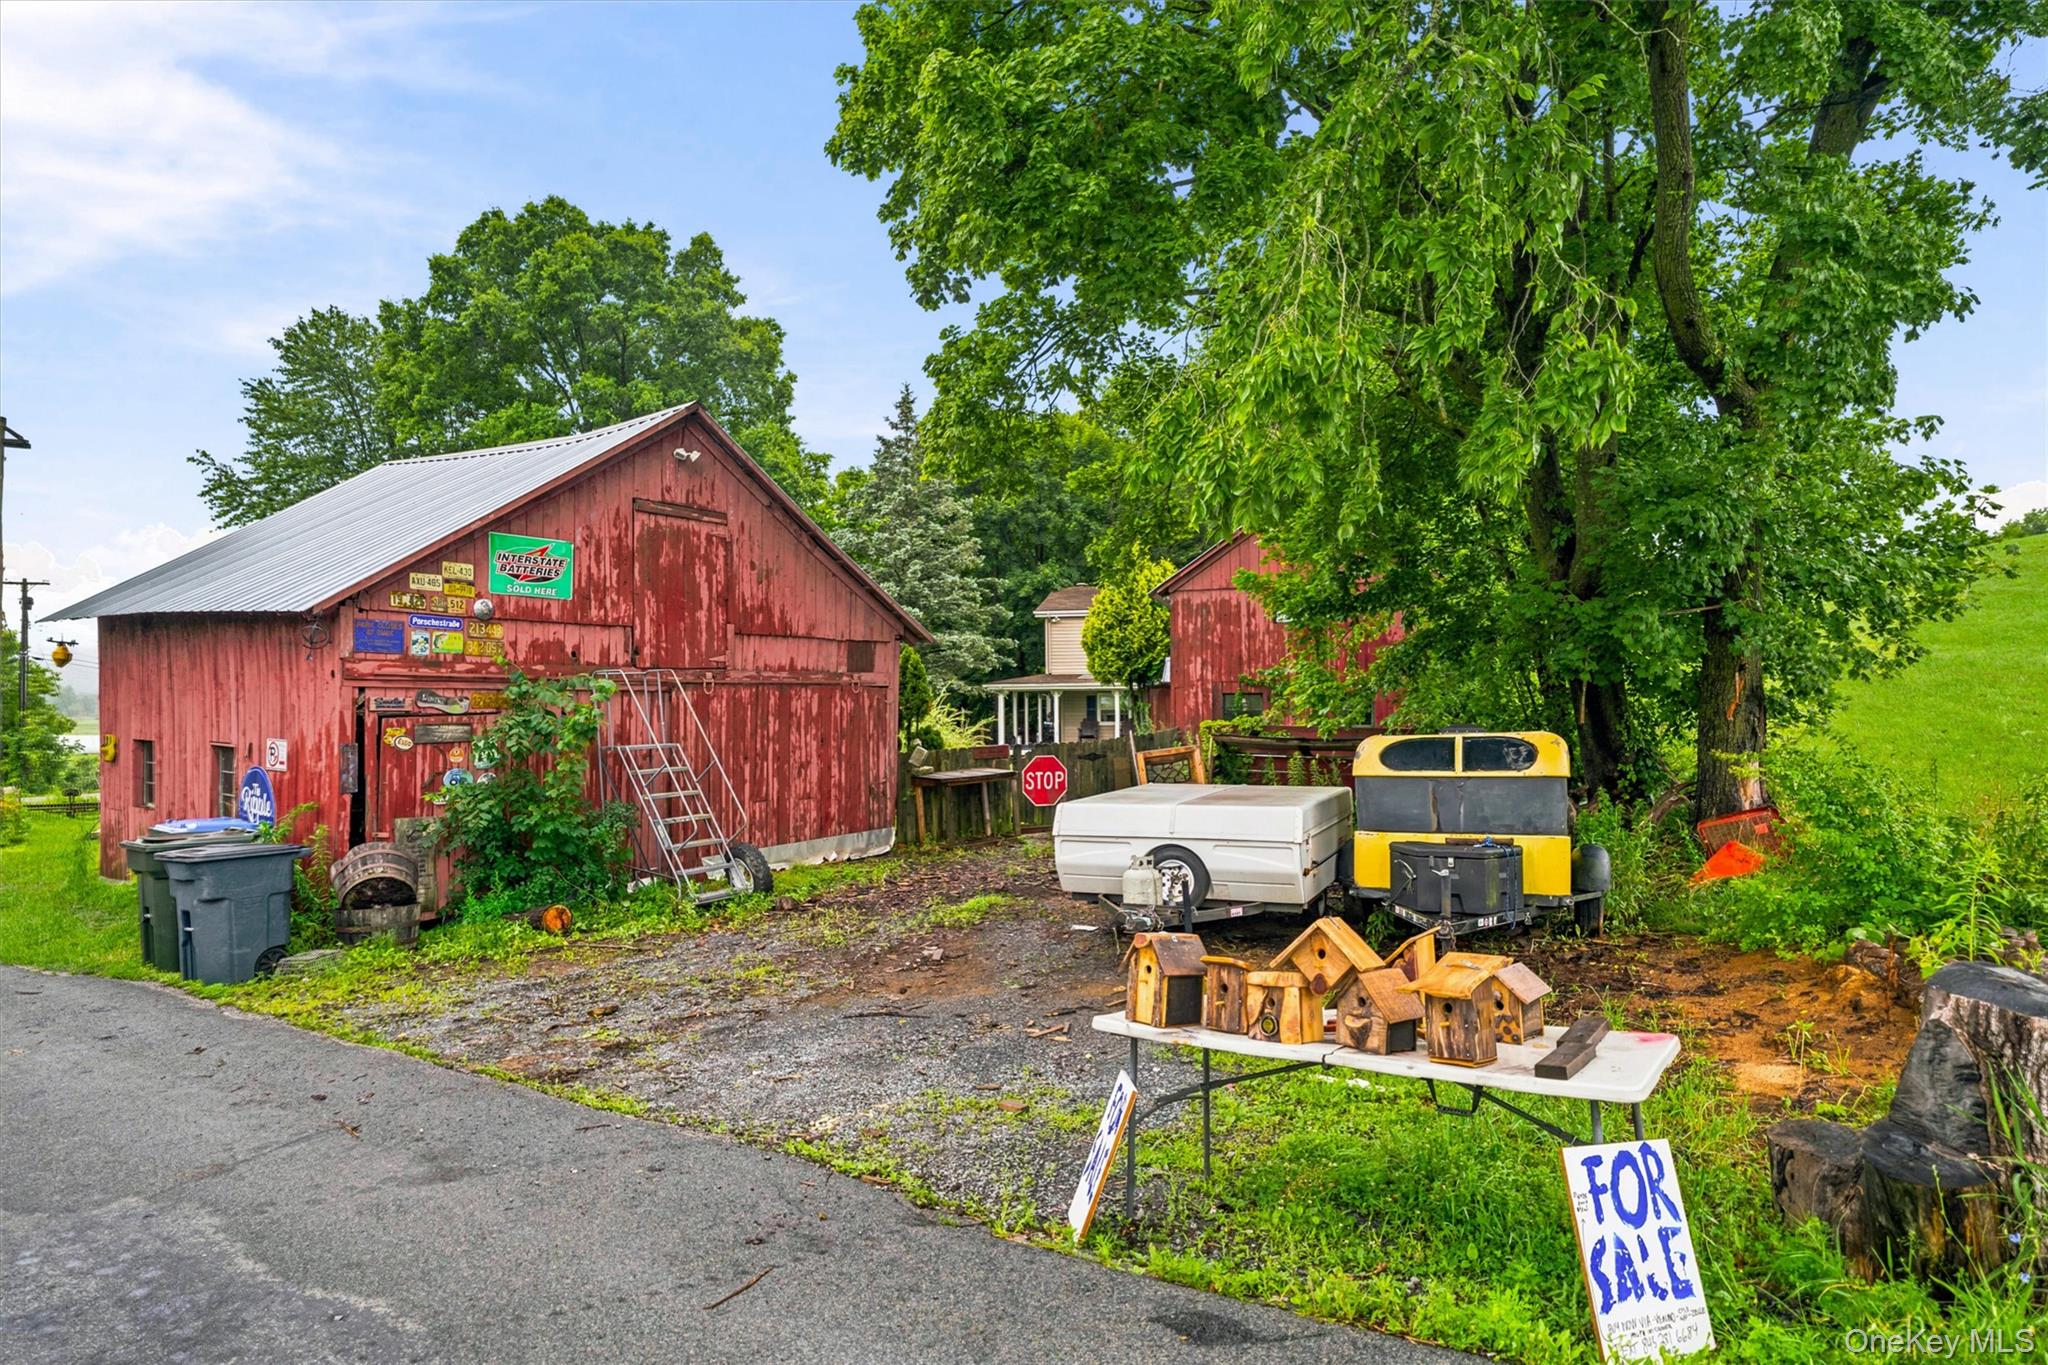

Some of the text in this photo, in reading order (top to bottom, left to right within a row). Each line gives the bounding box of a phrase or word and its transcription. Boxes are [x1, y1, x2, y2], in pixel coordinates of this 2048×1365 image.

[497, 552, 566, 568] INTERSTATE
[499, 563, 560, 577] BATTERIES
[506, 584, 558, 596] SOLD HERE
[1025, 771, 1064, 790] STOP
[1581, 1141, 1682, 1230] FOR
[1590, 1226, 1697, 1315] SALE
